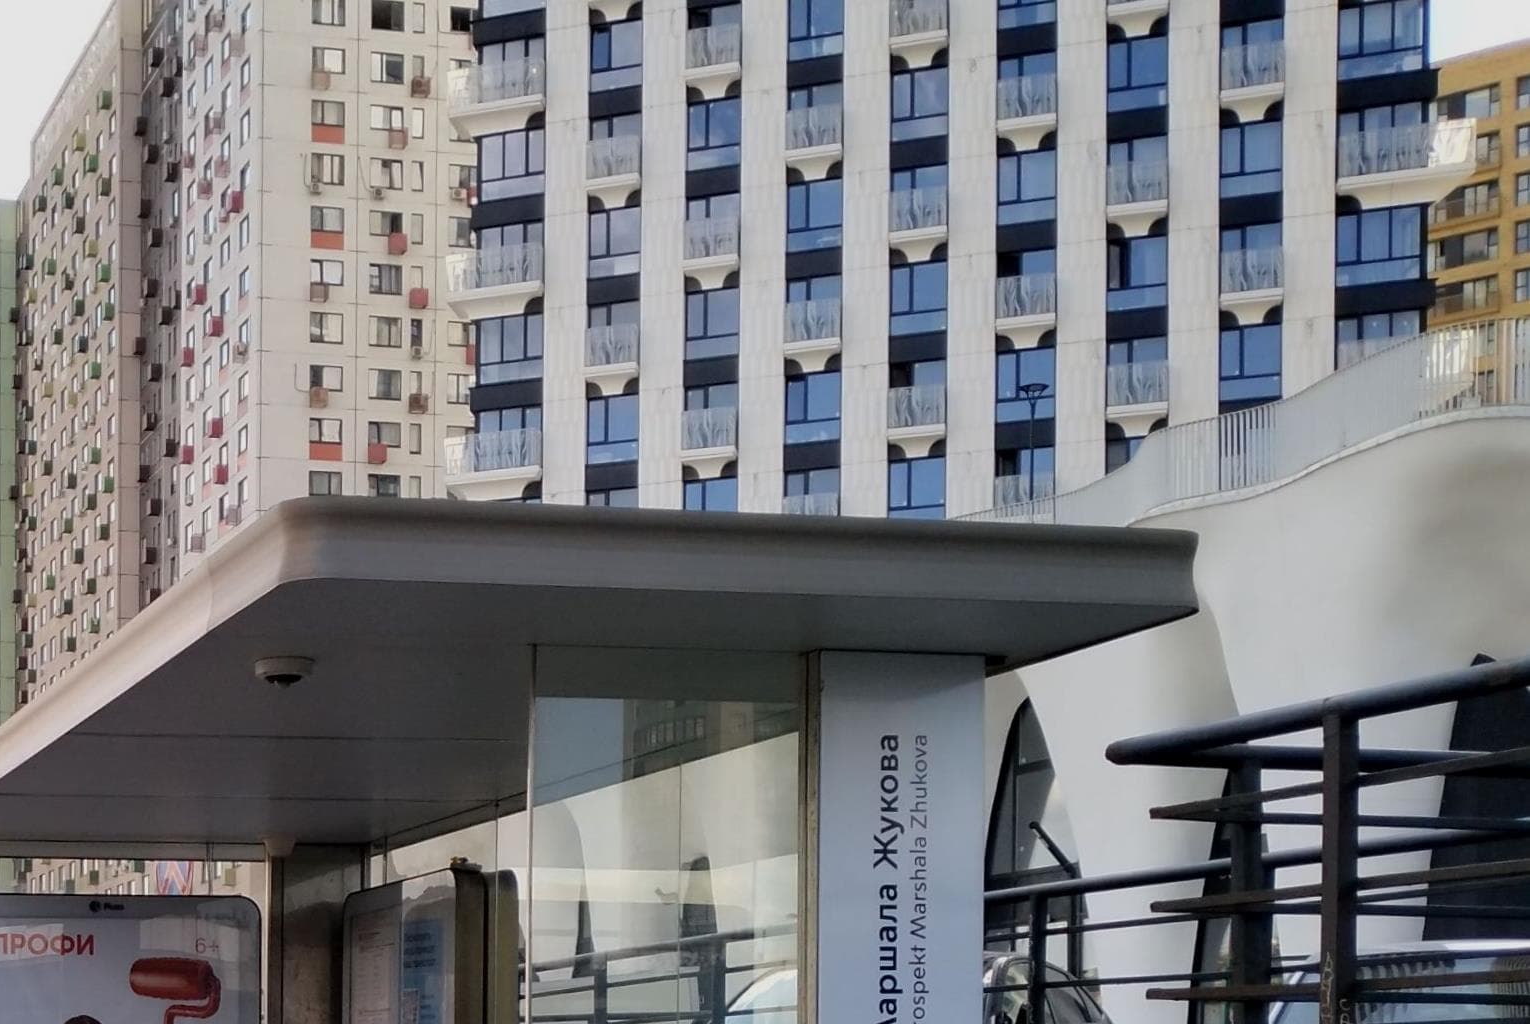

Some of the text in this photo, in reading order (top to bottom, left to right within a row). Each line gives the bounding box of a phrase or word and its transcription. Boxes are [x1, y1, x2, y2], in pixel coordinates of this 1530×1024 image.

[873, 734, 905, 870] Жукова
[910, 734, 928, 829] Zhukova
[909, 837, 928, 939] Marshala
[195, 937, 219, 954] 6+
